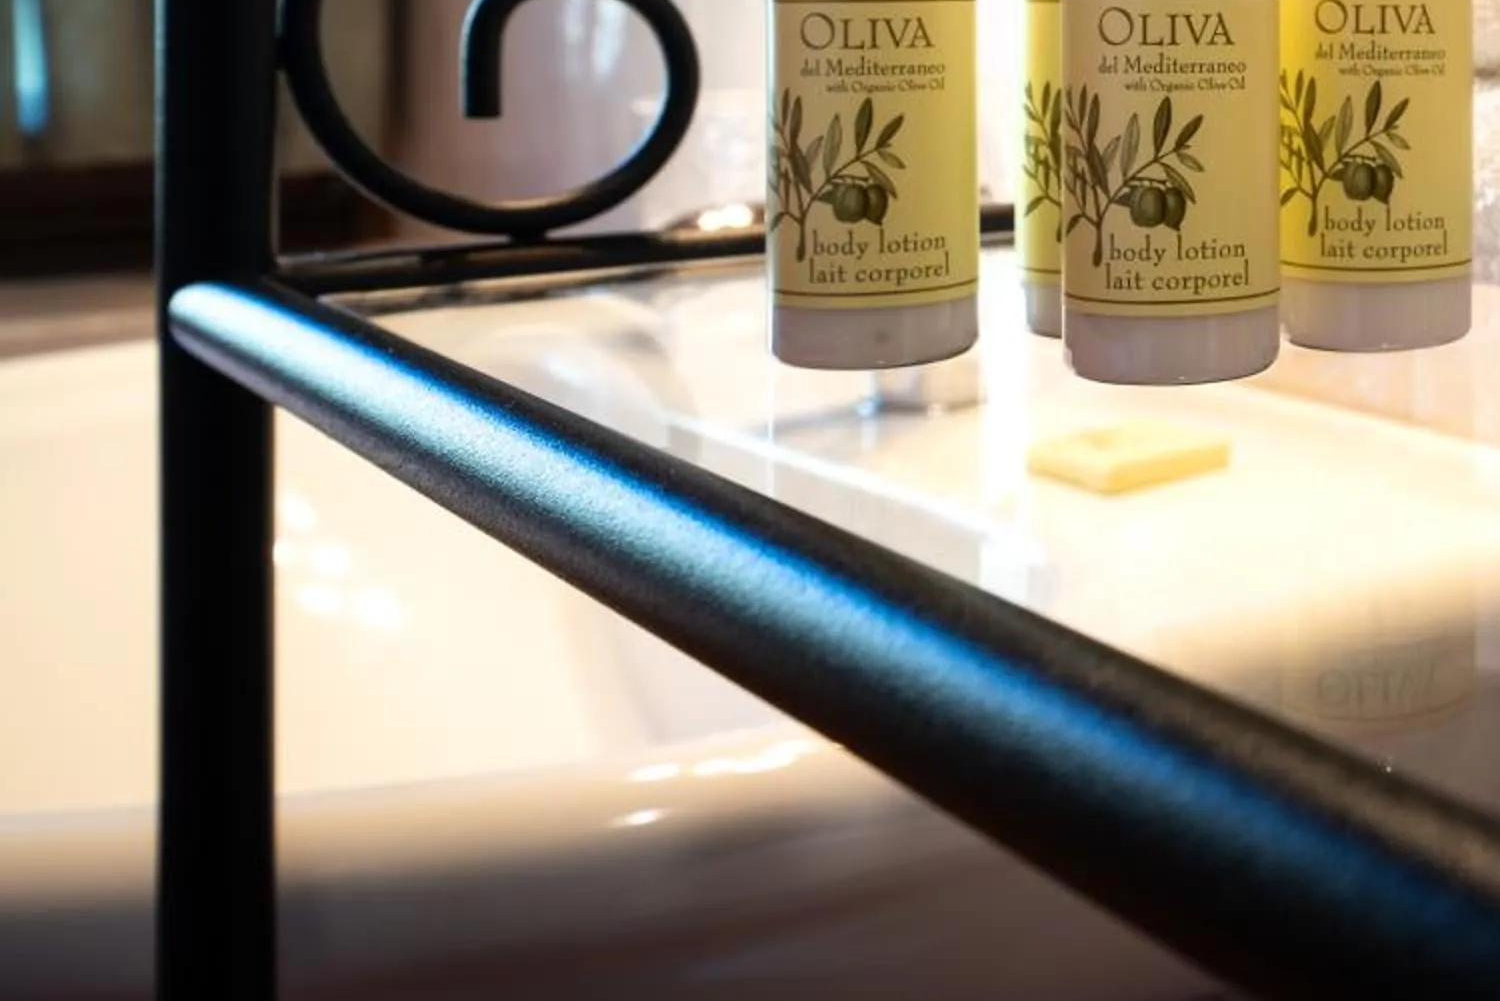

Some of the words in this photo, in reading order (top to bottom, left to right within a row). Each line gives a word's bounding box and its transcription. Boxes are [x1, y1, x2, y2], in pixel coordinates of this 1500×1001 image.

[800, 11, 935, 50] OLIVA
[1098, 6, 1235, 47] OLIVA
[825, 55, 946, 77] Mediterraneo
[1123, 52, 1247, 74] Mediterraneo
[1324, 205, 1376, 237] body
[1385, 203, 1445, 233] lotion
[812, 228, 872, 260] body
[879, 228, 946, 255] lotion
[1109, 233, 1166, 266] body
[1177, 232, 1246, 262] lotion
[1320, 233, 1356, 258] lait
[1362, 229, 1448, 262] corporel
[809, 258, 848, 285] lait
[855, 251, 950, 286] corporel
[1105, 263, 1145, 291] lait
[1152, 258, 1250, 296] corporel
